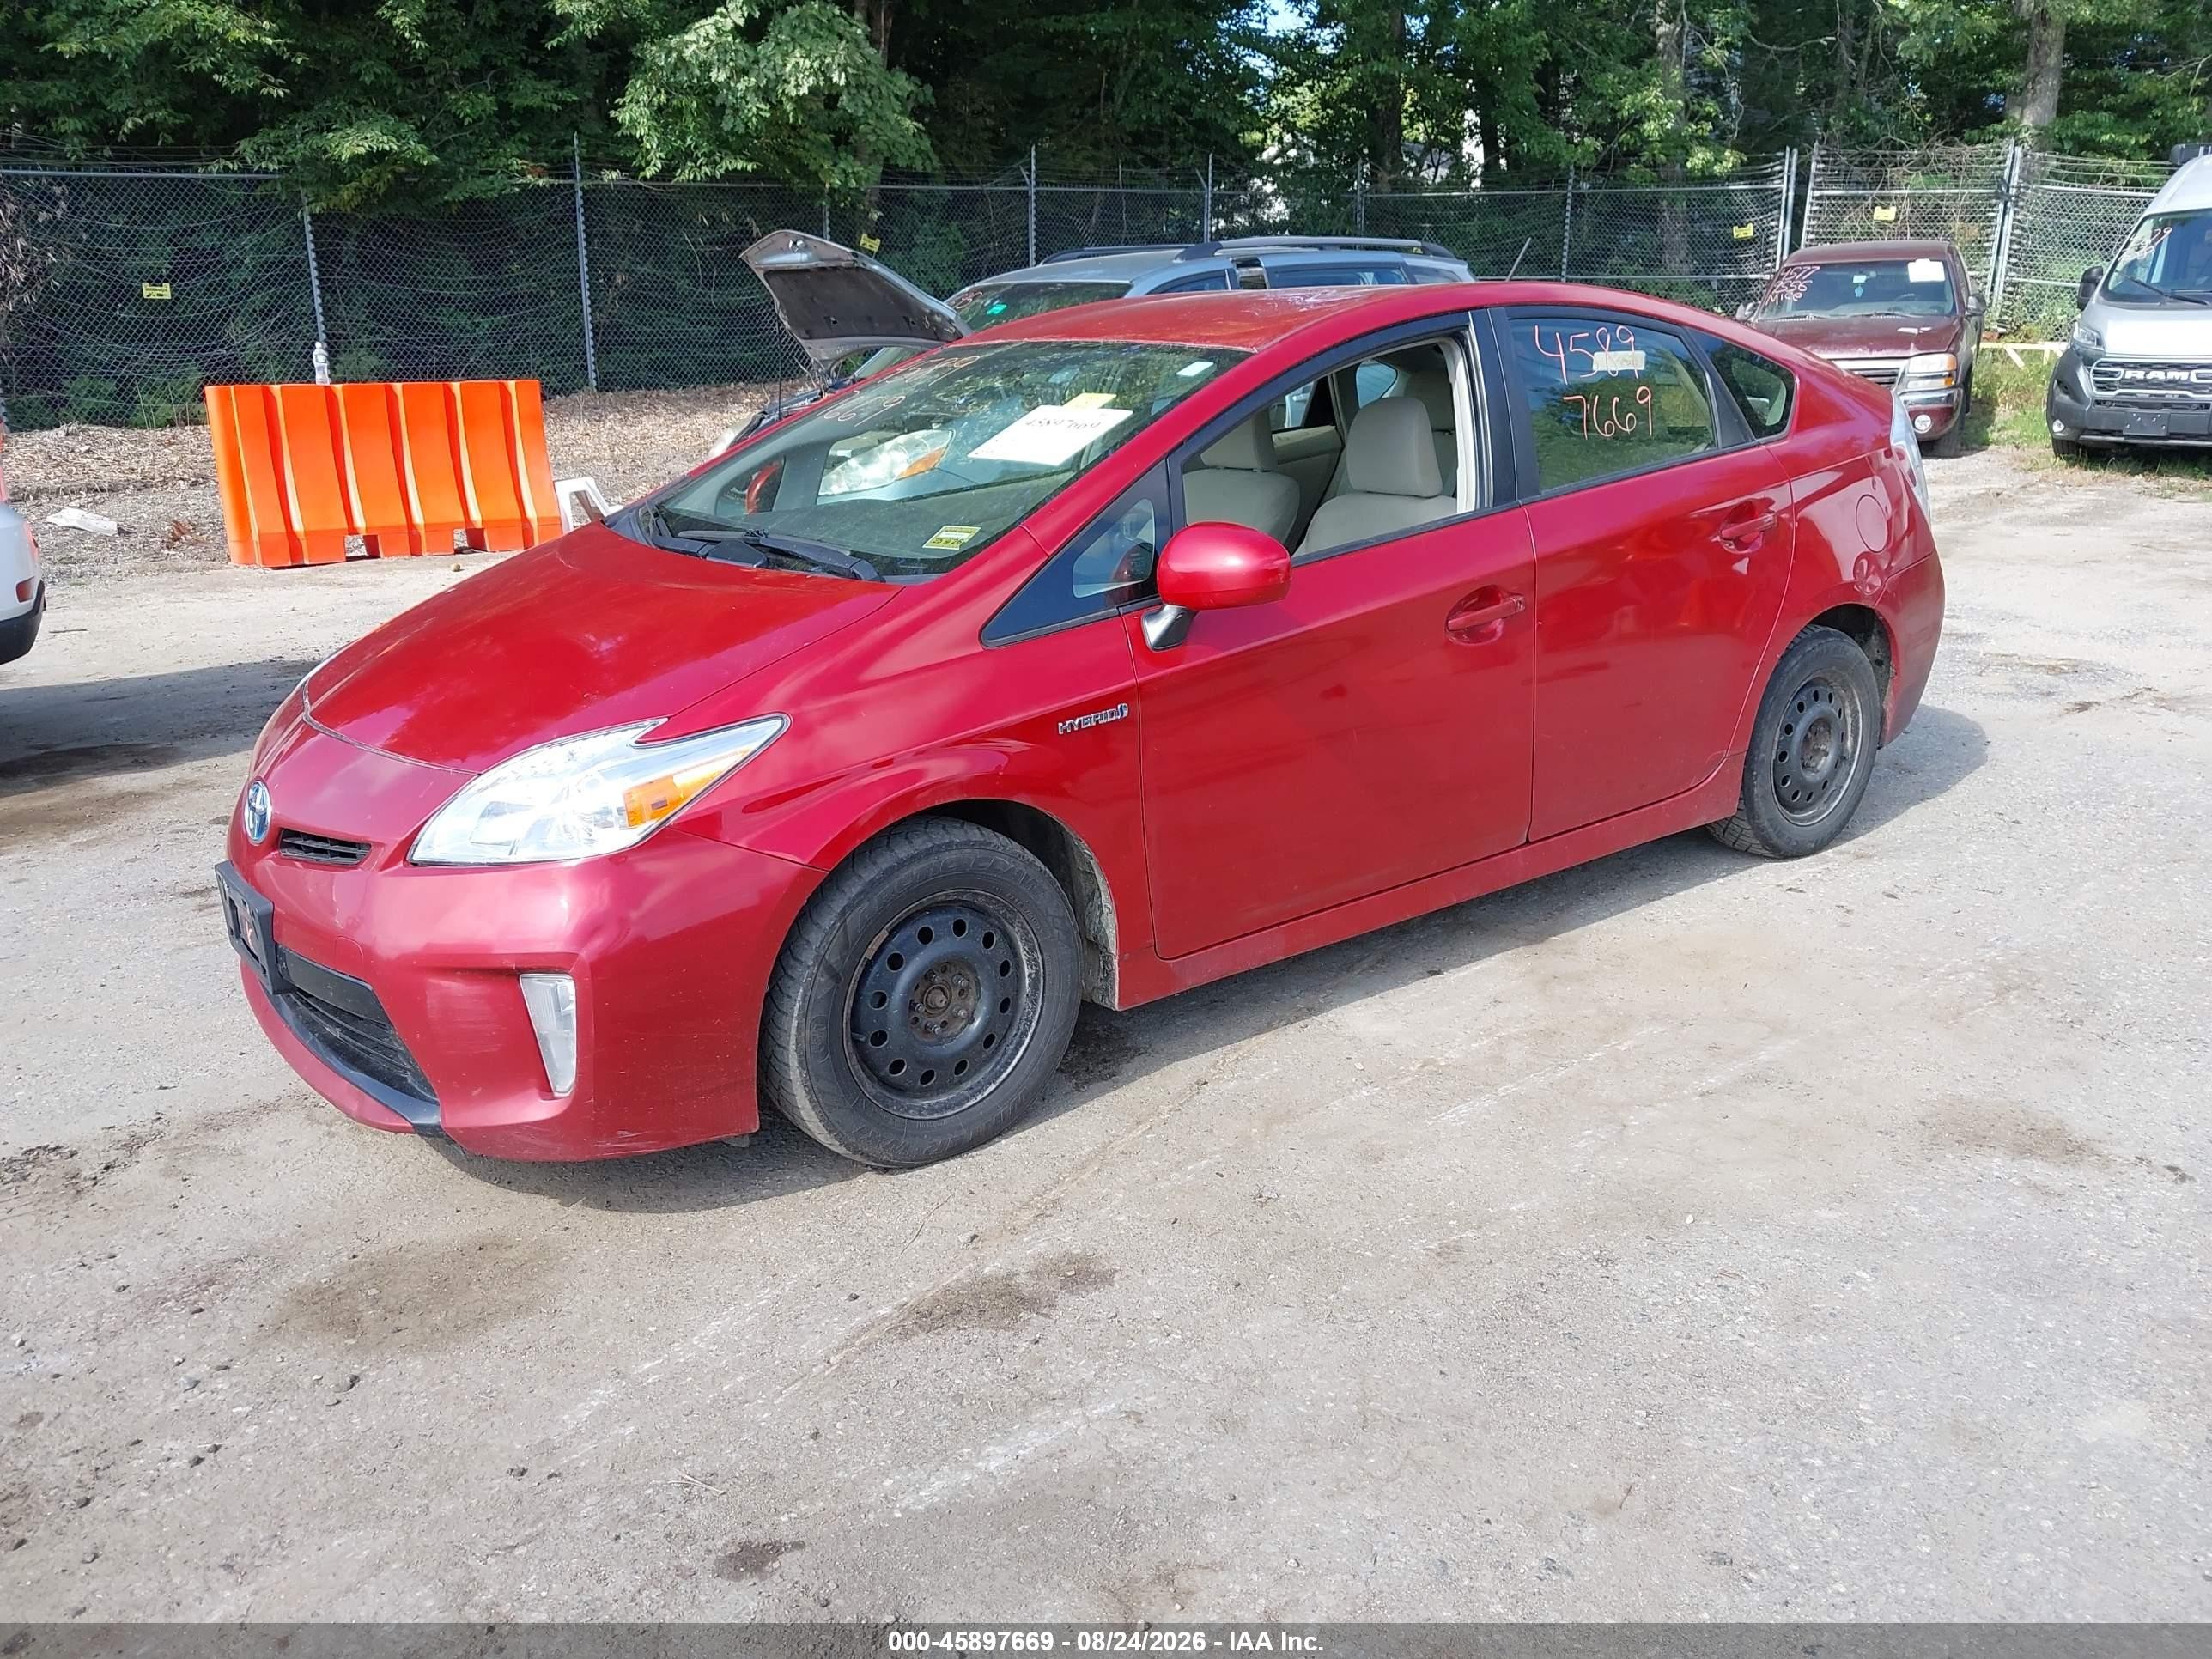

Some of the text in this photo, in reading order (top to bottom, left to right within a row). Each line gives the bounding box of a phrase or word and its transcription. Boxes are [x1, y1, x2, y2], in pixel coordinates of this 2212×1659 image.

[1781, 266, 1820, 281] 4577
[1772, 280, 1814, 294] 2556
[1535, 325, 1639, 386] 4589
[2124, 370, 2190, 380] RAM
[1563, 386, 1654, 441] 7669
[1058, 708, 1119, 735] HYBRID
